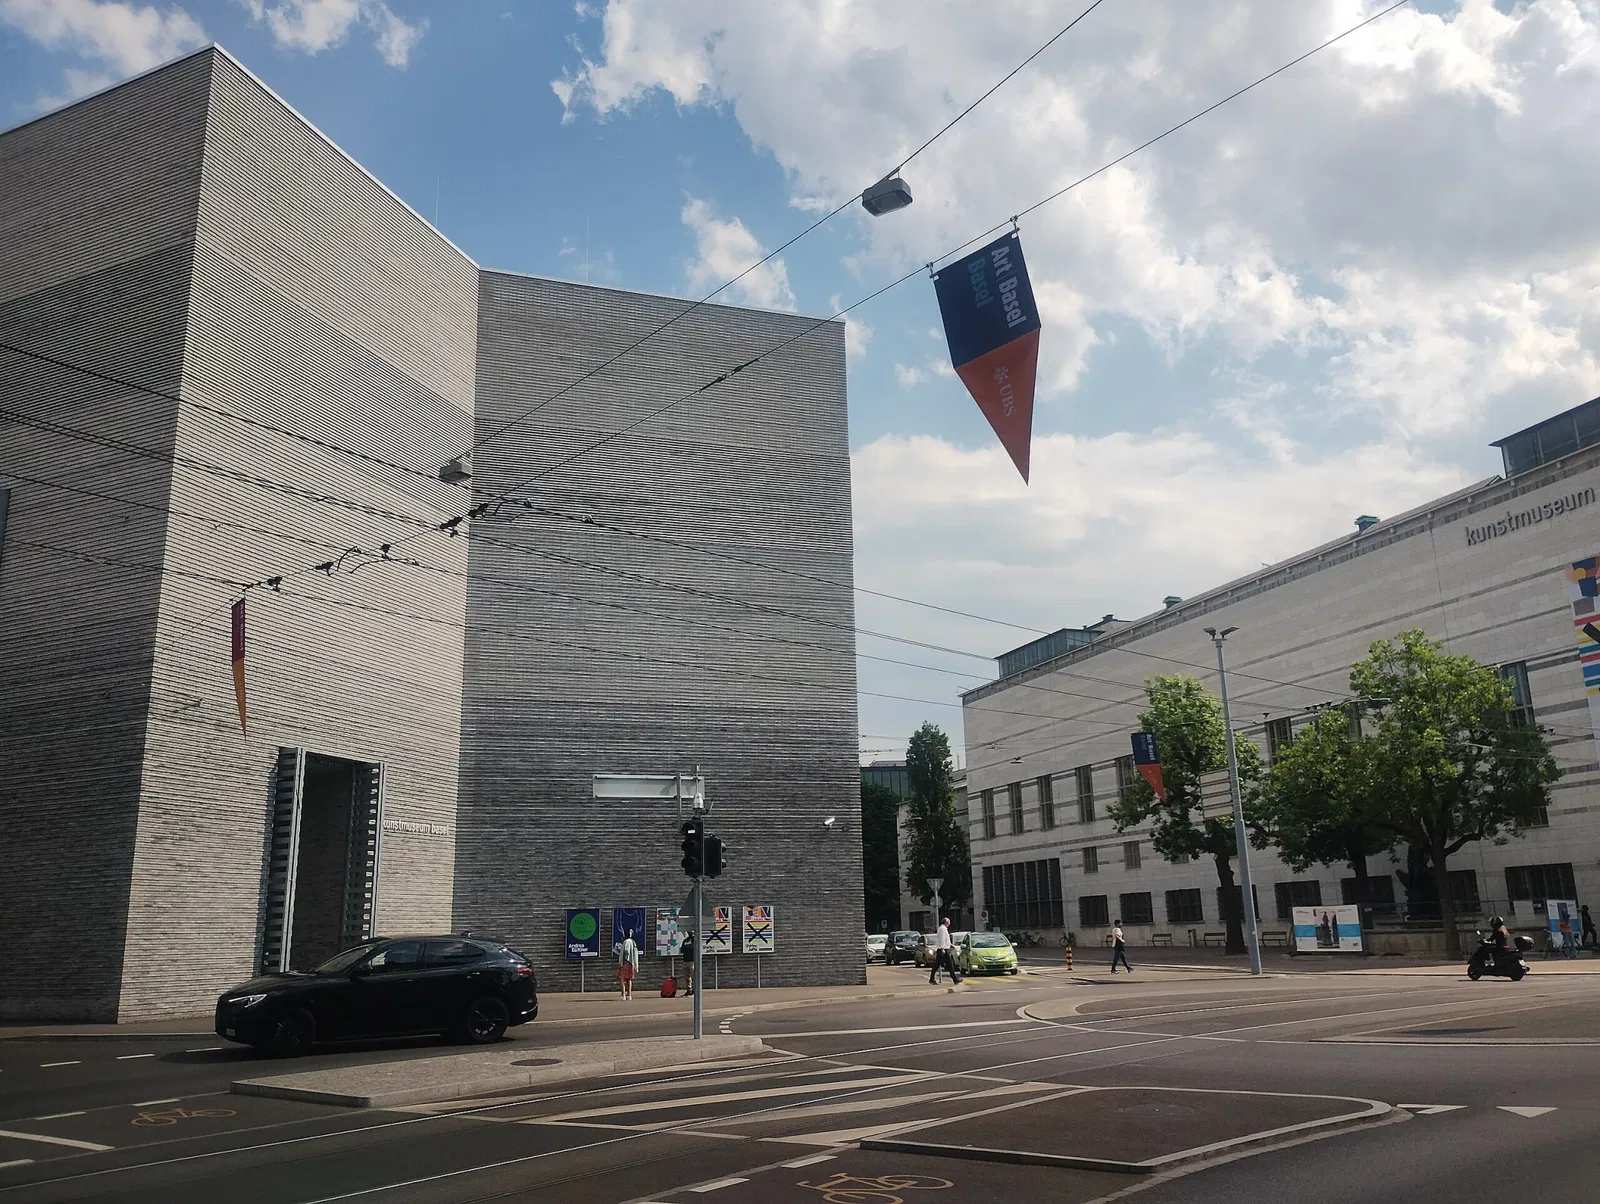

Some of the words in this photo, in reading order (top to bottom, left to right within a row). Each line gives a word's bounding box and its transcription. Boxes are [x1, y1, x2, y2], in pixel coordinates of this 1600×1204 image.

[968, 256, 995, 308] Basel
[991, 246, 1012, 276] Art
[998, 276, 1027, 328] Basel
[1000, 384, 1016, 417] UBS
[1465, 487, 1596, 547] kunstmuseum
[431, 823, 449, 835] basel
